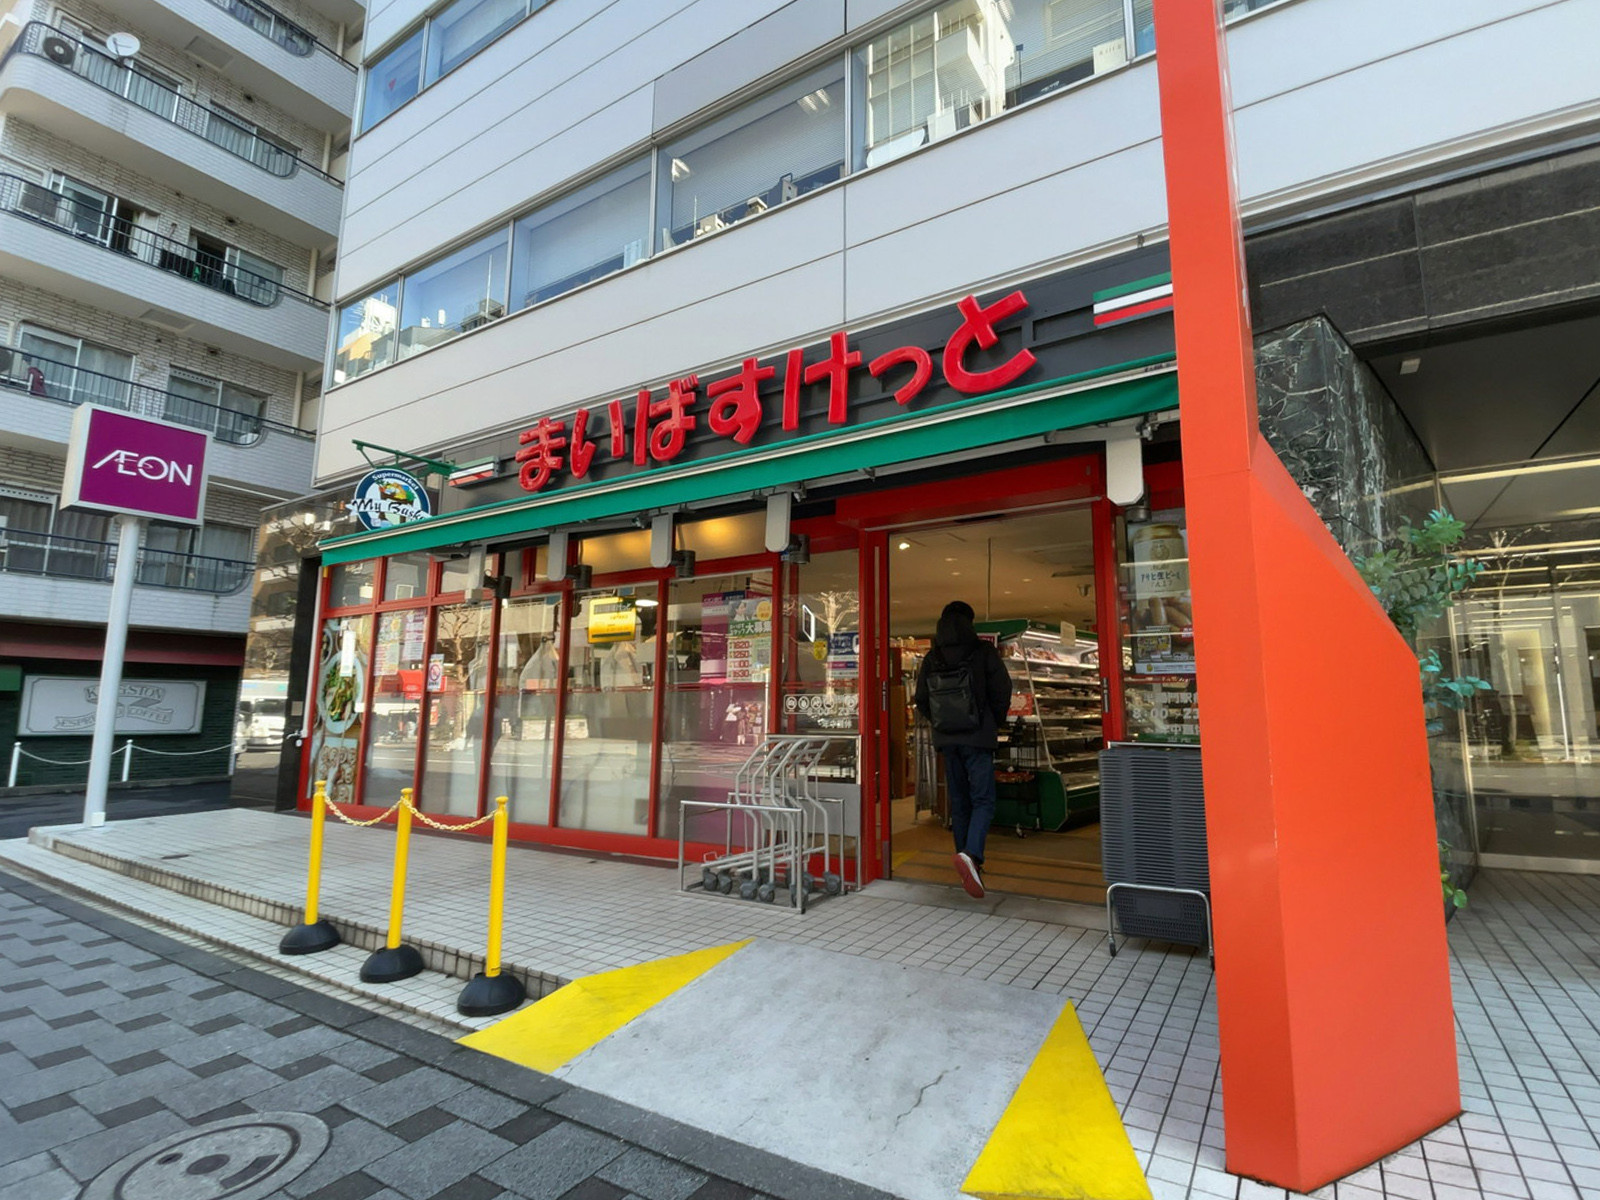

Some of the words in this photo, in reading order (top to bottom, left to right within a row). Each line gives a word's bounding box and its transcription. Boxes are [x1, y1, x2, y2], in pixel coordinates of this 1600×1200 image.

[515, 290, 1038, 492] まいばすけっと
[372, 471, 420, 492] Supermarket
[351, 498, 382, 513] My
[86, 684, 162, 699] KGSTON
